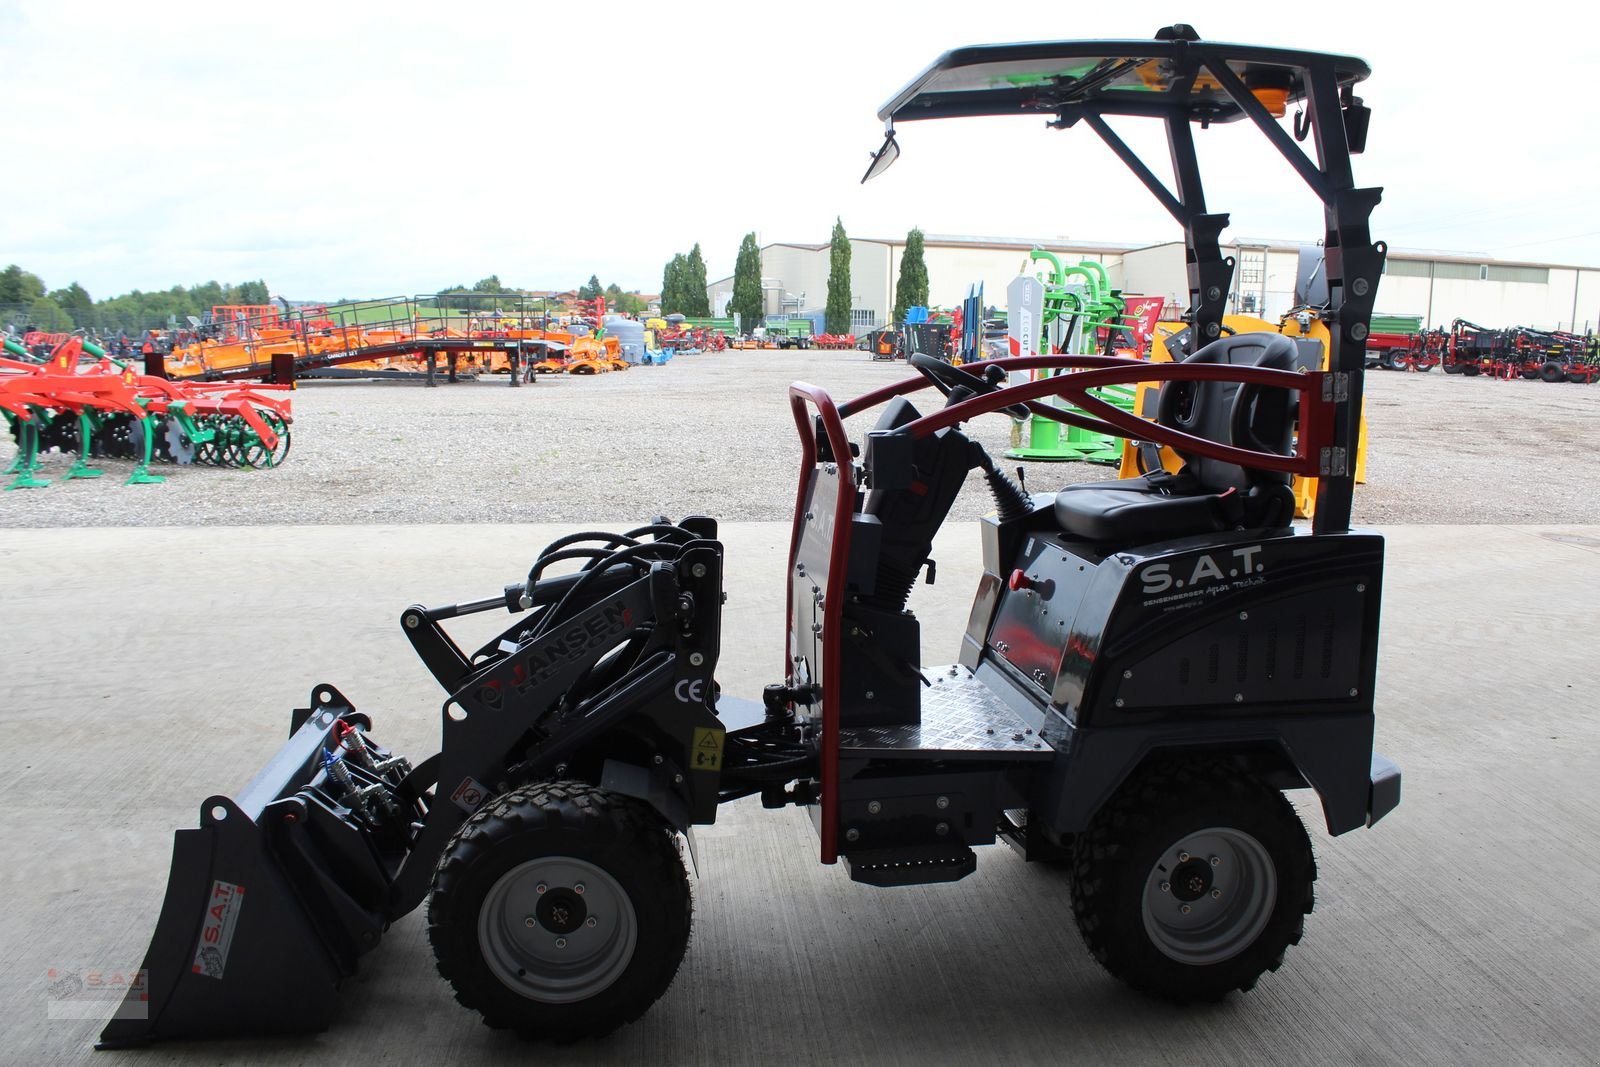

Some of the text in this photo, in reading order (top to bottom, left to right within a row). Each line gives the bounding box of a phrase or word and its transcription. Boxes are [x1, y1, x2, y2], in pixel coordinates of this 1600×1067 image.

[1140, 545, 1264, 594] S.A.T.
[510, 600, 627, 687] JANSEN
[674, 679, 703, 703] CE
[203, 883, 231, 945] S.A.T.
